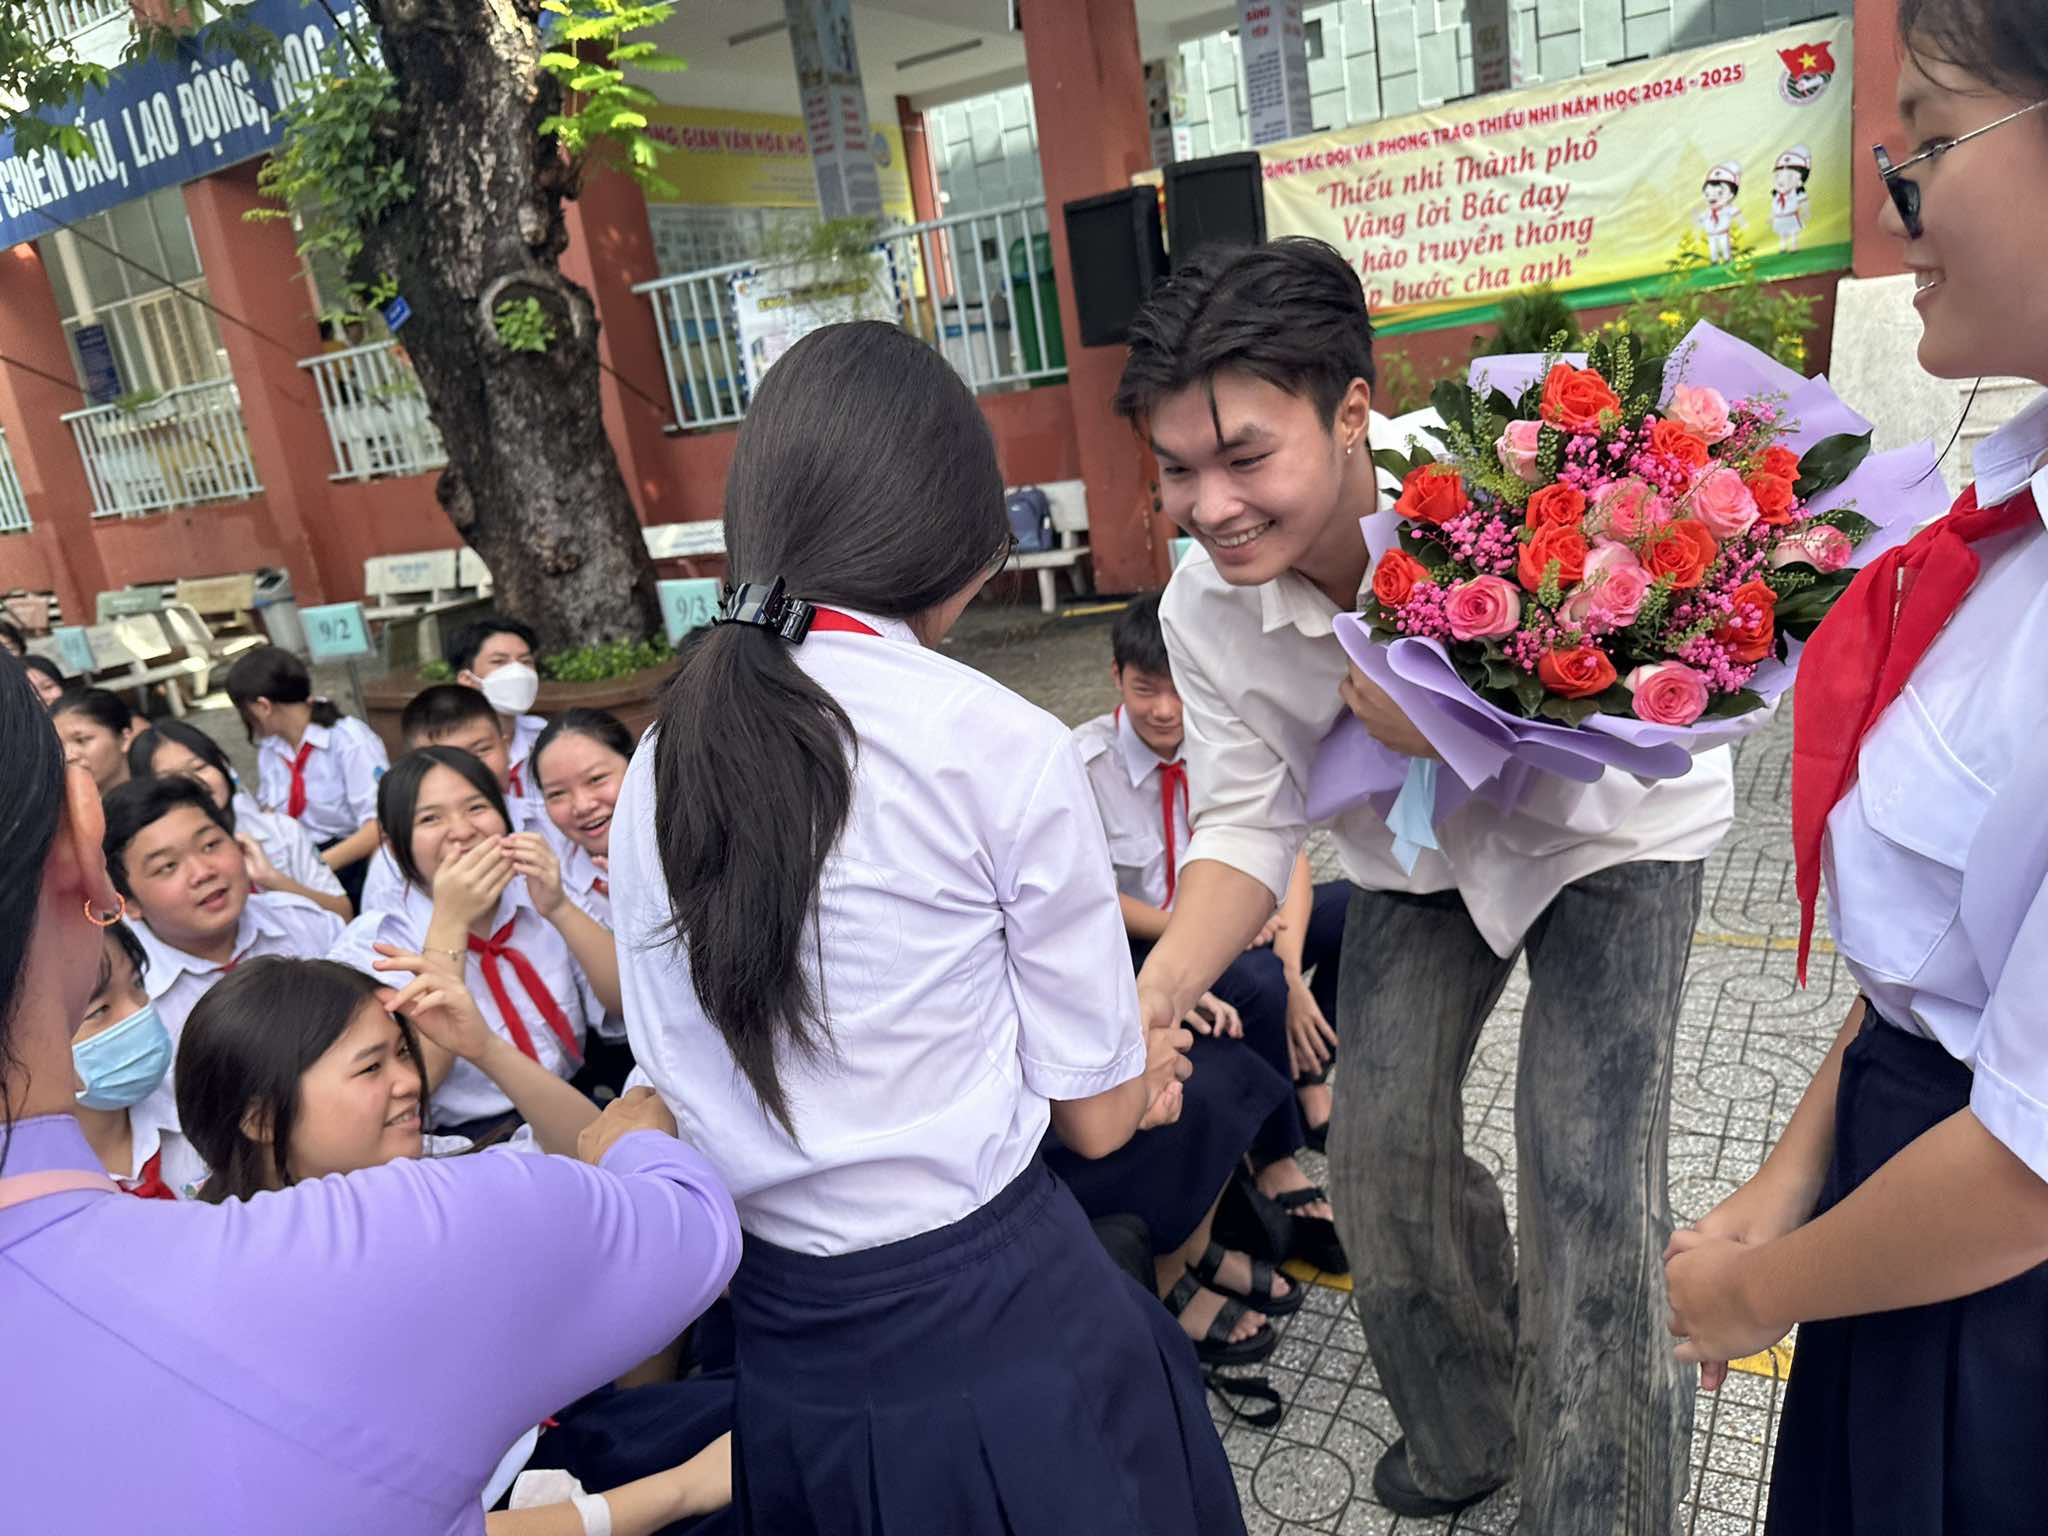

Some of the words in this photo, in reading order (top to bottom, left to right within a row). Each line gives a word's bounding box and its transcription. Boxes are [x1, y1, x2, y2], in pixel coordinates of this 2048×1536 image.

[121, 91, 180, 169] LAO
[176, 58, 271, 156] ĐỘNG,
[1263, 159, 1296, 180] ÔNG
[1377, 130, 1430, 156] PHONG
[1478, 106, 1525, 136] THIẾU
[1528, 104, 1558, 126] NHI
[1561, 94, 1600, 118] NĂM
[1600, 86, 1640, 112] HỌC
[1641, 76, 1685, 101] 2024
[1700, 64, 1744, 89] 2025
[1402, 160, 1443, 195] nhi
[1455, 145, 1537, 185] Thành
[1545, 125, 1603, 174] phố
[1343, 210, 1407, 241] Vâng
[1416, 196, 1452, 230] lời
[1461, 190, 1511, 222] Bác
[1519, 180, 1571, 215] dạy
[1361, 243, 1408, 275] hào
[1417, 222, 1505, 265] truyền
[1515, 209, 1595, 245] thống
[1391, 270, 1455, 306] bước
[1463, 264, 1510, 294] cha
[1520, 247, 1589, 285] anh”
[318, 617, 352, 642] 9/2
[674, 595, 709, 624] 9/3
